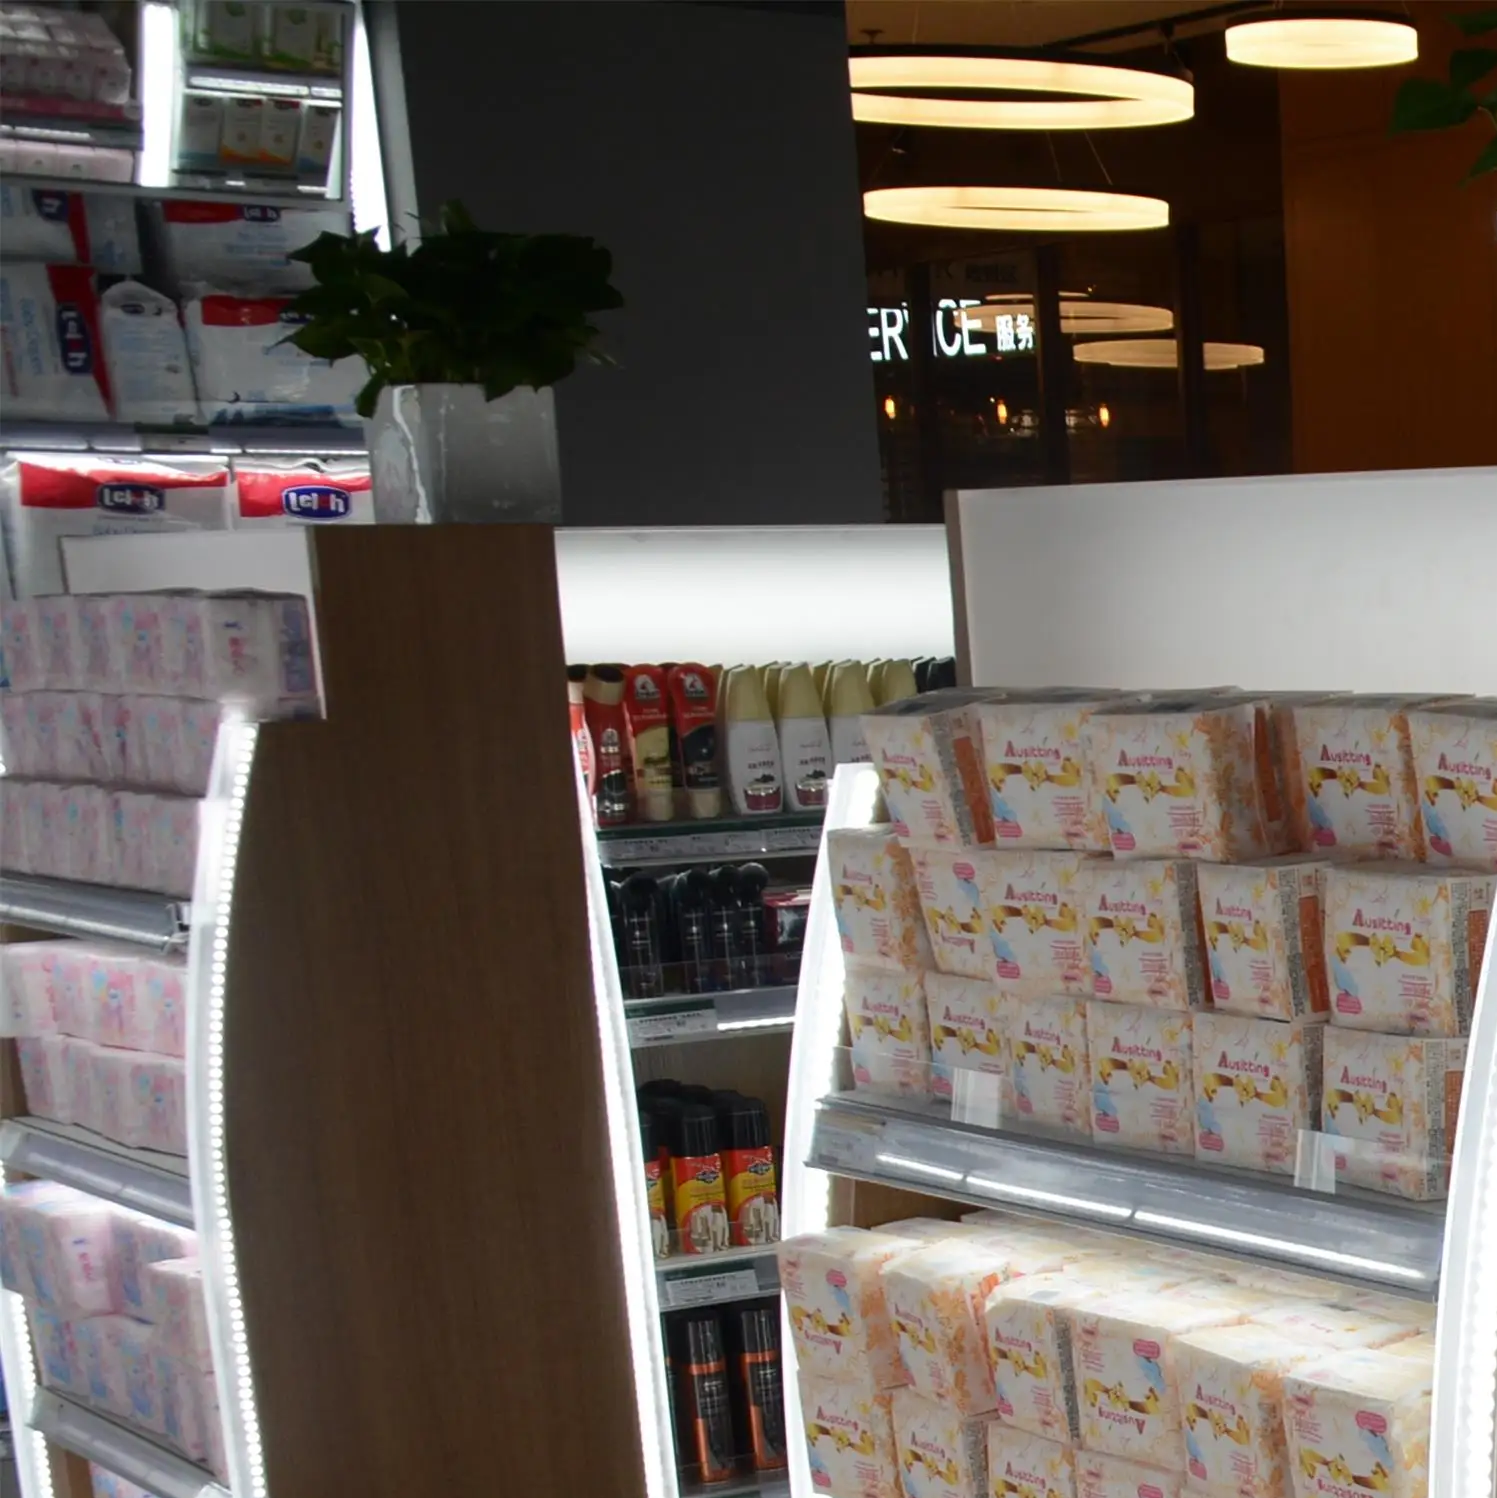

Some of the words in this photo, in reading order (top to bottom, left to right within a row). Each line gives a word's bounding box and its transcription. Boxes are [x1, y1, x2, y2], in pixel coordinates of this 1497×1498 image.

[996, 314, 1035, 352] 服务
[1119, 750, 1173, 769] Ausitting
[1320, 744, 1371, 766] Ausitting
[1438, 752, 1492, 779] Ausitting
[1352, 908, 1412, 935] Ausitting
[1218, 1051, 1270, 1077] Ausitting
